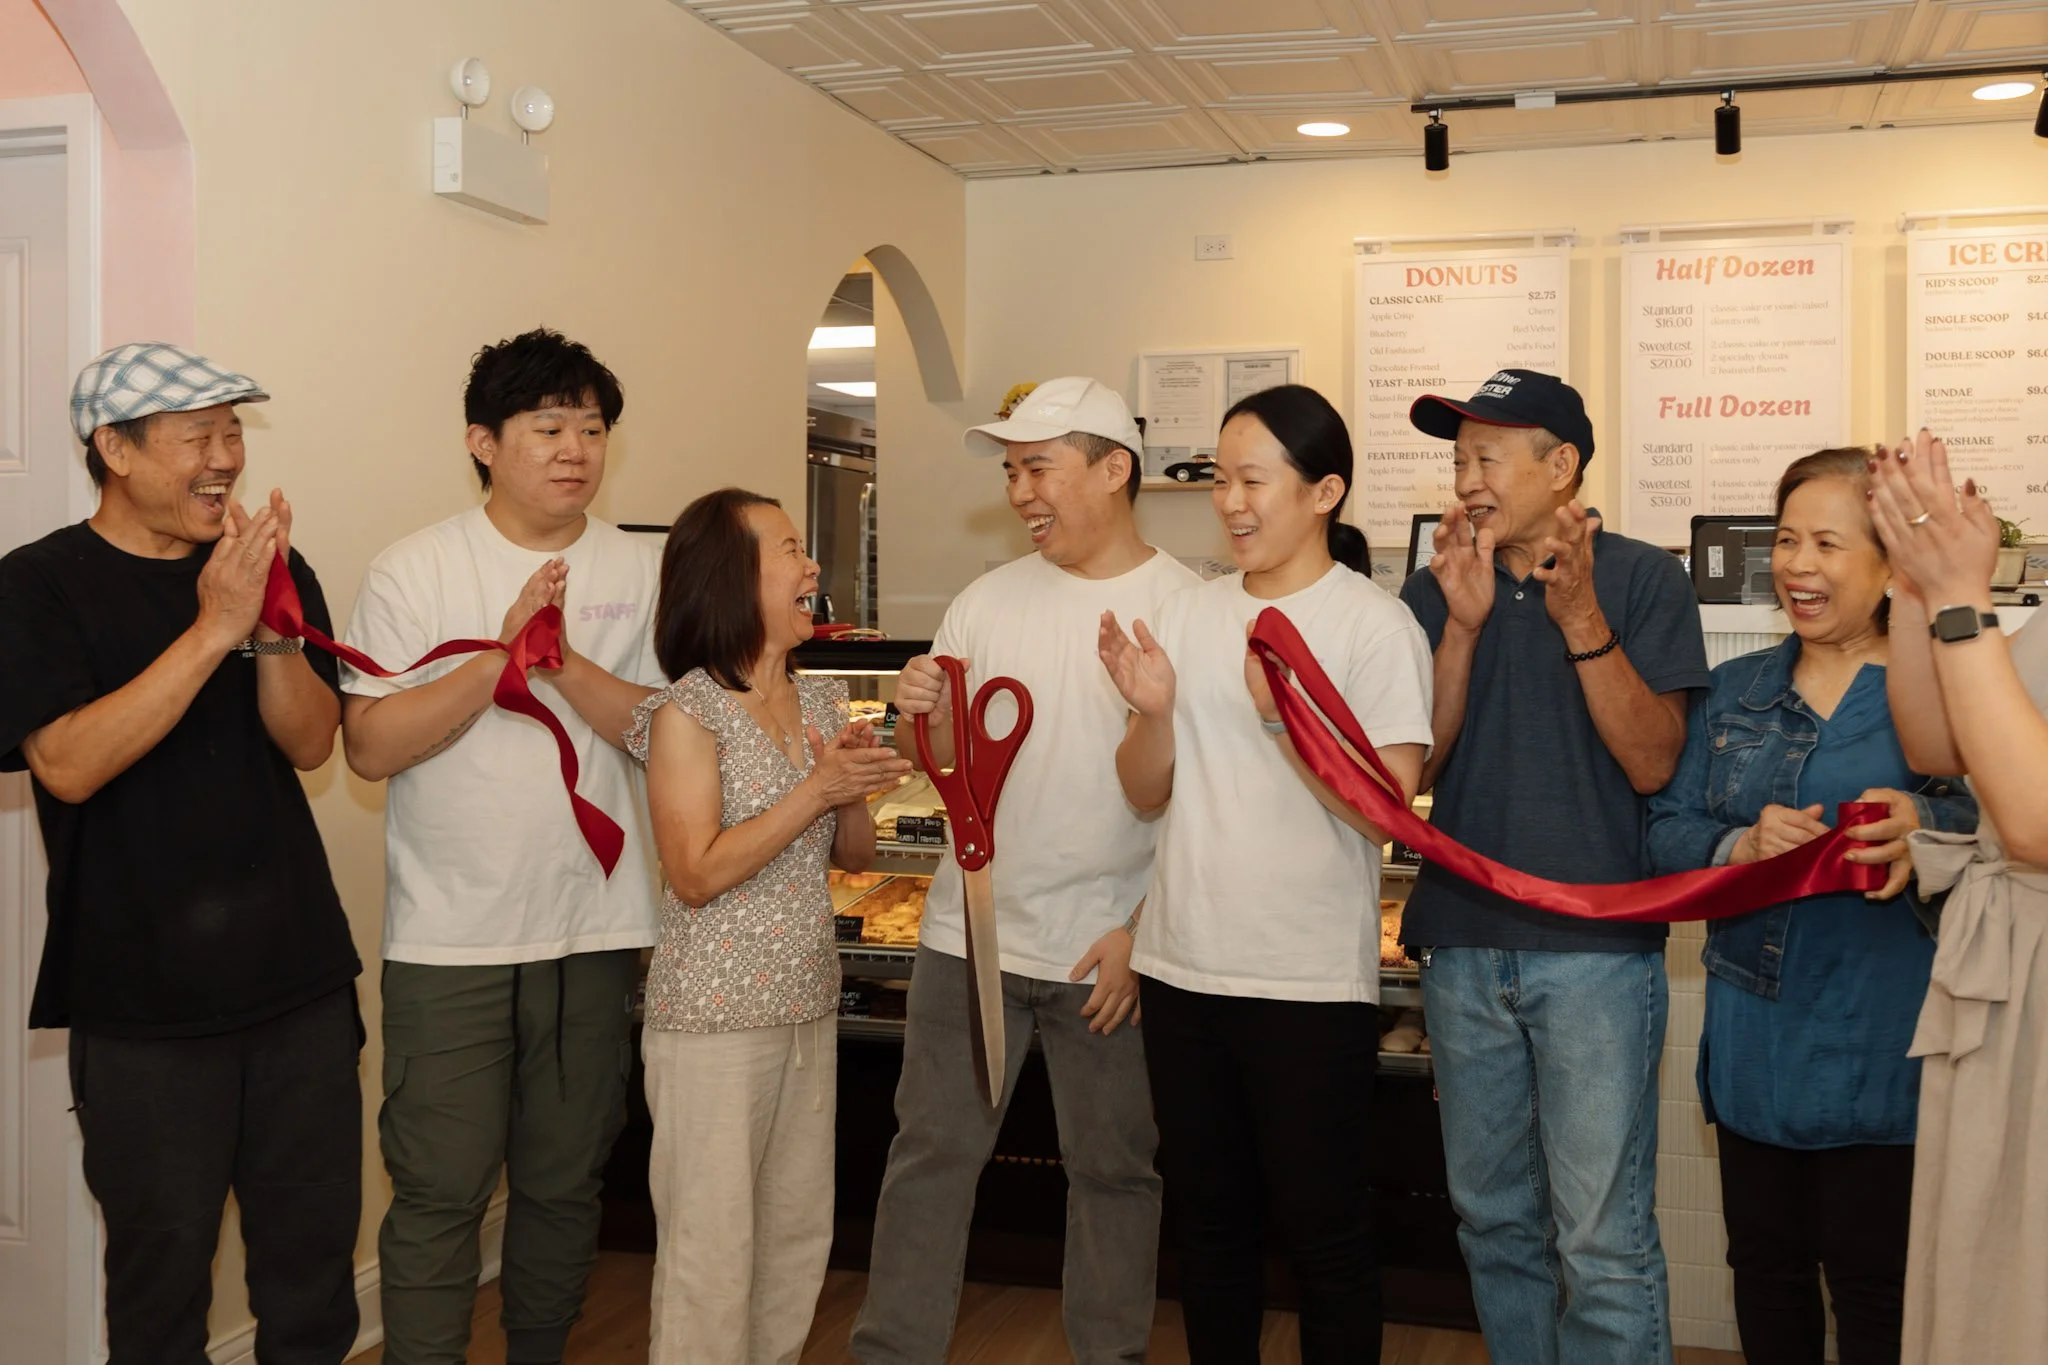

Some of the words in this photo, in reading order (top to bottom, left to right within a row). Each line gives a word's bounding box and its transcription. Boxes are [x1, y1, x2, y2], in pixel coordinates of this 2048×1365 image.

[1949, 243, 1997, 266] ICE
[2003, 241, 2048, 264] CR
[1406, 263, 1518, 288] DONUTS
[1656, 256, 1718, 285] Half
[1723, 255, 1815, 278] Dozen
[1958, 277, 1999, 288] SCOOP
[1369, 295, 1414, 305] CLASSIC
[1415, 294, 1444, 304] CAKE
[1528, 291, 1556, 301] $2.75
[1642, 304, 1693, 316] Standard
[1369, 312, 1392, 322] Apple
[1924, 315, 1968, 325] SINGLE
[1970, 313, 2010, 323] SCOOP
[1655, 317, 1693, 329] $16.00
[1639, 341, 1692, 352] Sweetest
[1925, 352, 1973, 361] DOUBLE
[1975, 350, 2015, 360] SCOOP
[1650, 358, 1692, 370] $20.00
[1369, 378, 1447, 388] YEAST-RAISED
[1925, 388, 1973, 398] SUNDAE
[1659, 396, 1713, 419] Full
[1719, 395, 1811, 417] Dozen
[1642, 443, 1693, 454] Standard
[1367, 452, 1419, 460] FEATURED
[1420, 451, 1454, 460] FLAVO
[1651, 455, 1693, 467] $28.00
[1638, 479, 1692, 490] Sweetest
[1650, 495, 1692, 508] $39.00
[579, 602, 636, 621] STAFF
